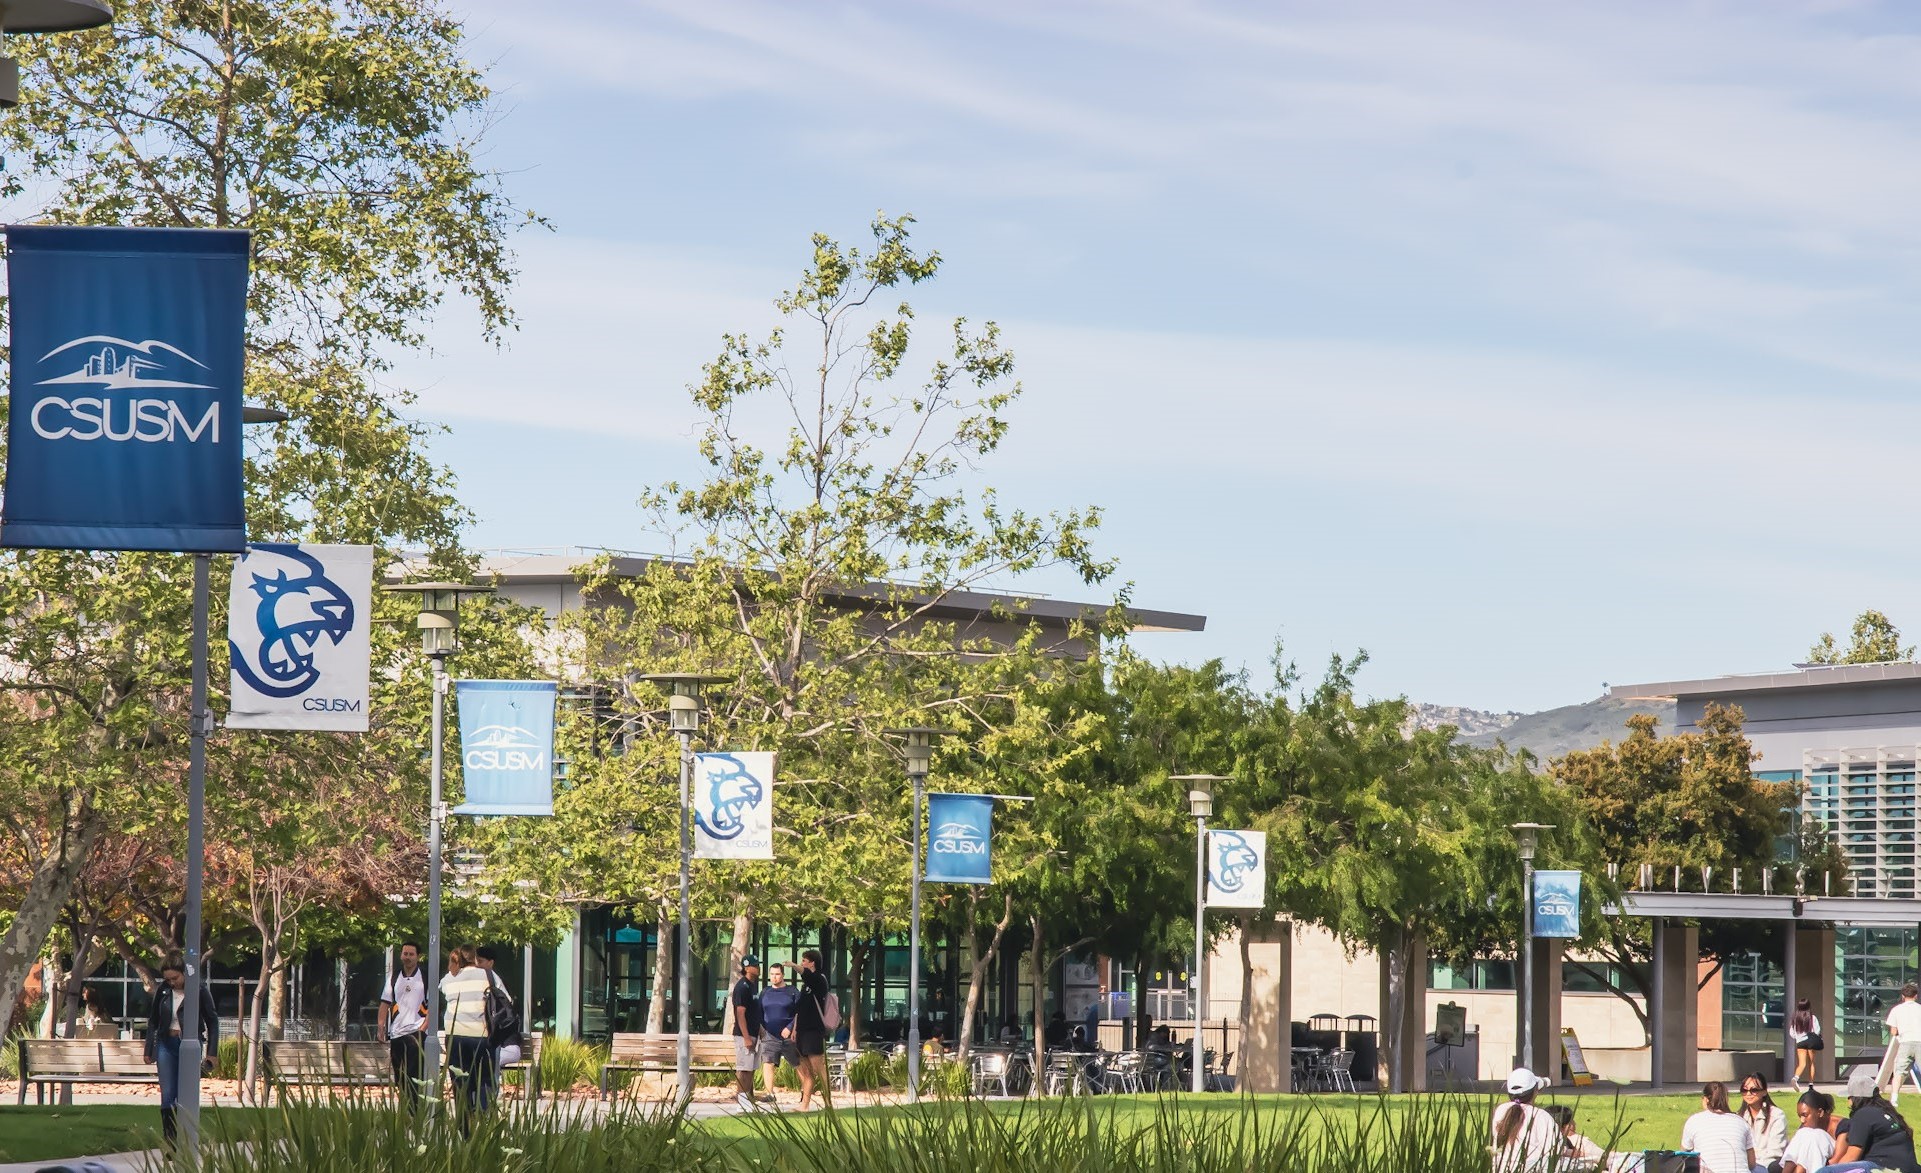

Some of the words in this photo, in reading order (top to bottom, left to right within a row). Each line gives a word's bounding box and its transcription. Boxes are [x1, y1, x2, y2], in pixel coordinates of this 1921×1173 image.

[31, 396, 219, 443] CSUSM
[303, 698, 360, 712] CSUSM
[465, 751, 544, 770] CSUSM
[933, 840, 985, 854] CSUSM
[1538, 905, 1575, 916] CSUSM
